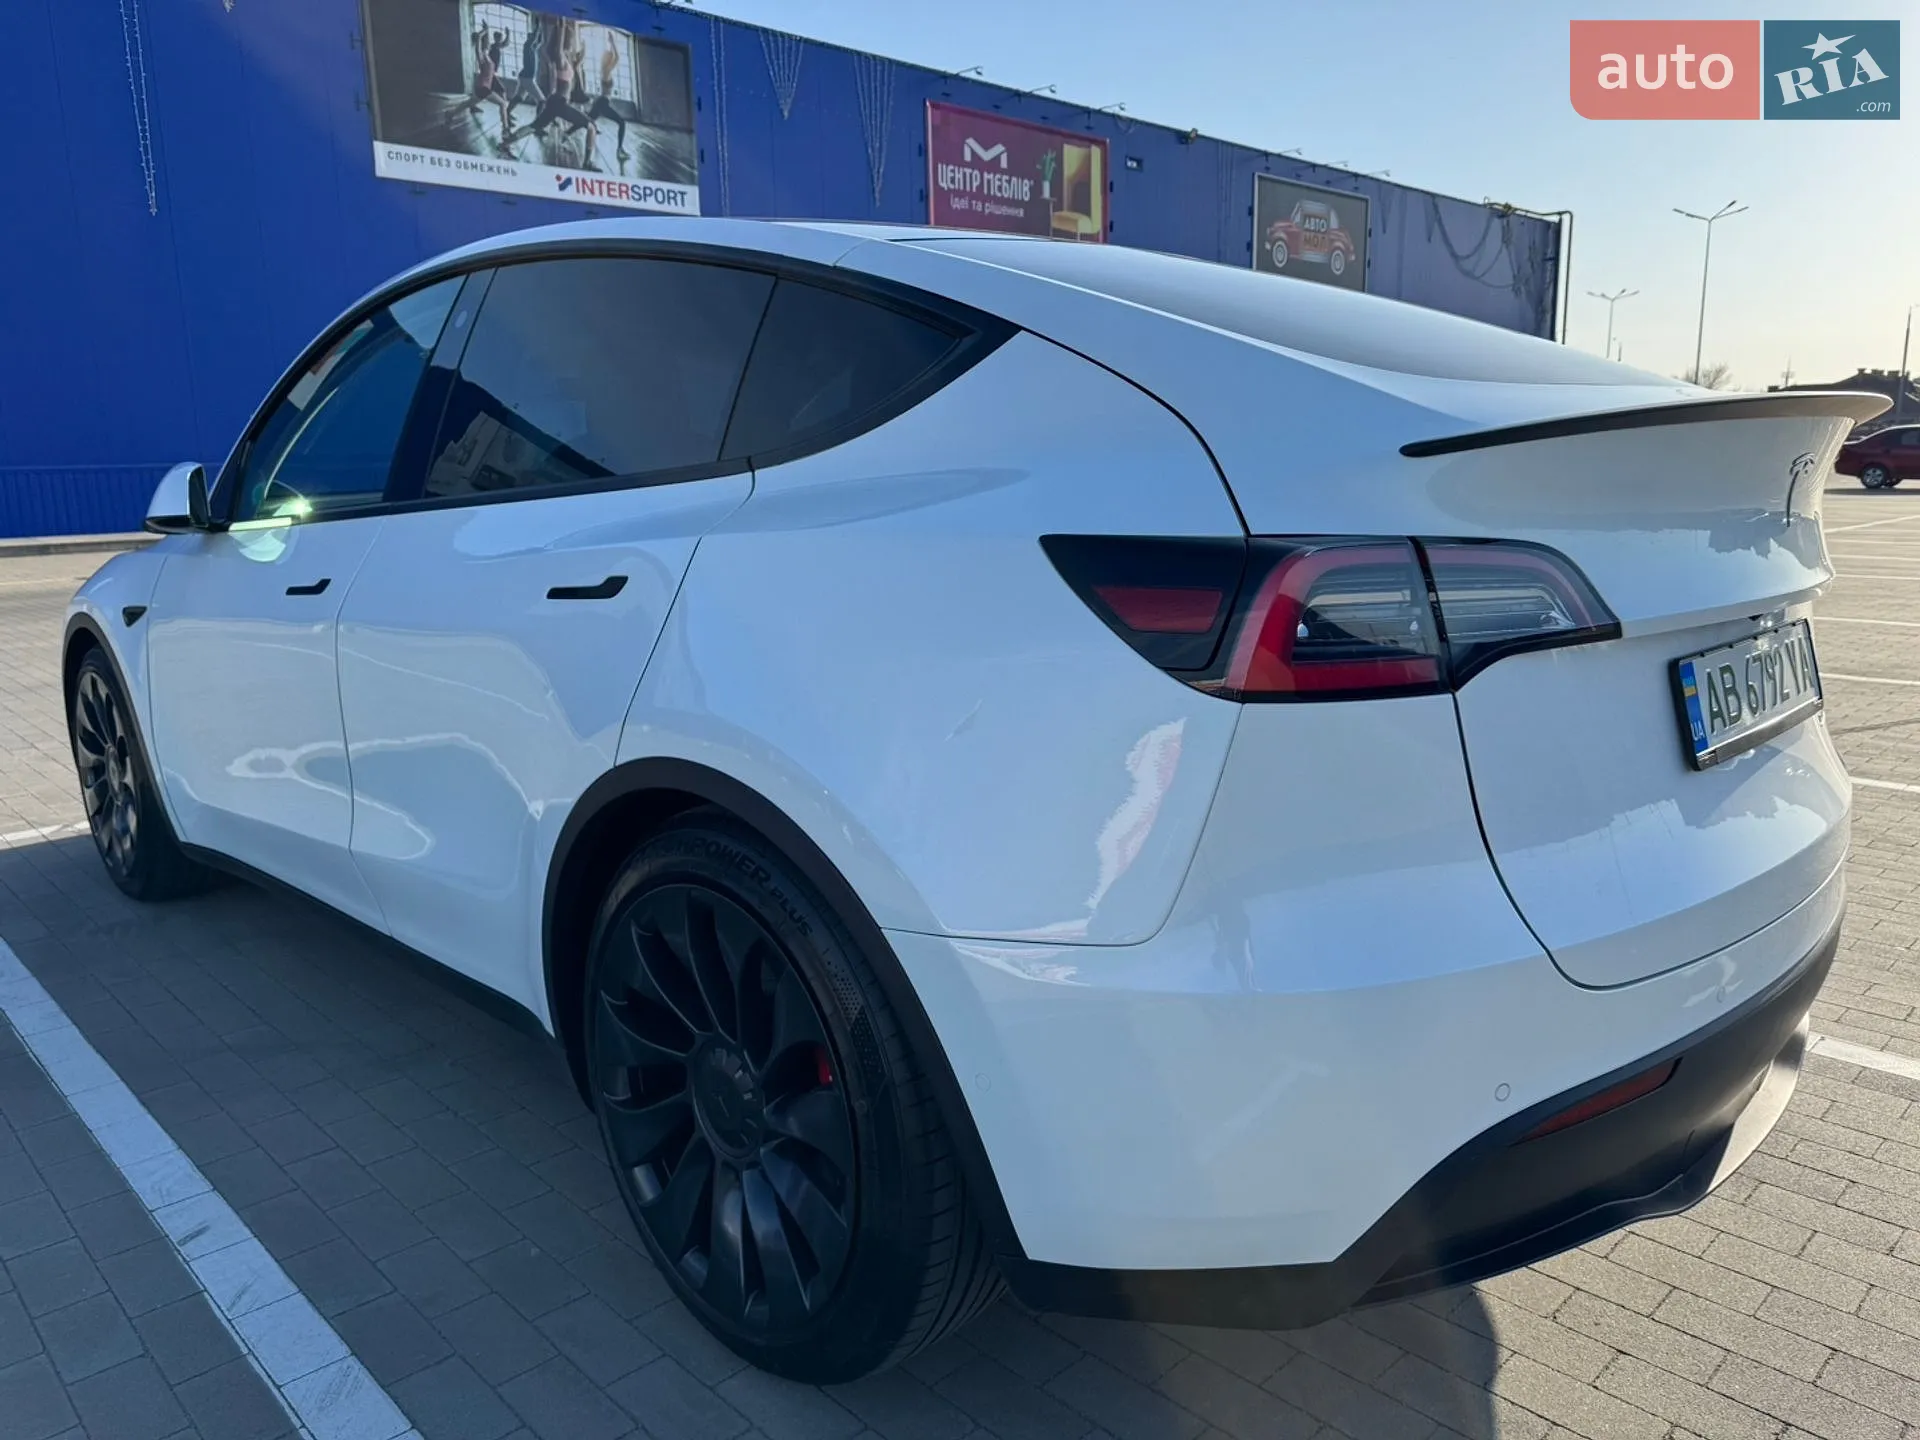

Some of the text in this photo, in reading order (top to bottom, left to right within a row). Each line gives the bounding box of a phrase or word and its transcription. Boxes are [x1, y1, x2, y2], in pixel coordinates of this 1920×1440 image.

[386, 150, 519, 177] СПОРТ БЕЗ ОБМЕЖЕНЬ
[574, 176, 688, 208] INTERSPORT
[937, 162, 1031, 202] ЦЕНТР МЕБЛІВ
[1745, 644, 1791, 717] 6792
[1690, 720, 1705, 741] UA
[771, 886, 814, 937] PLUS
